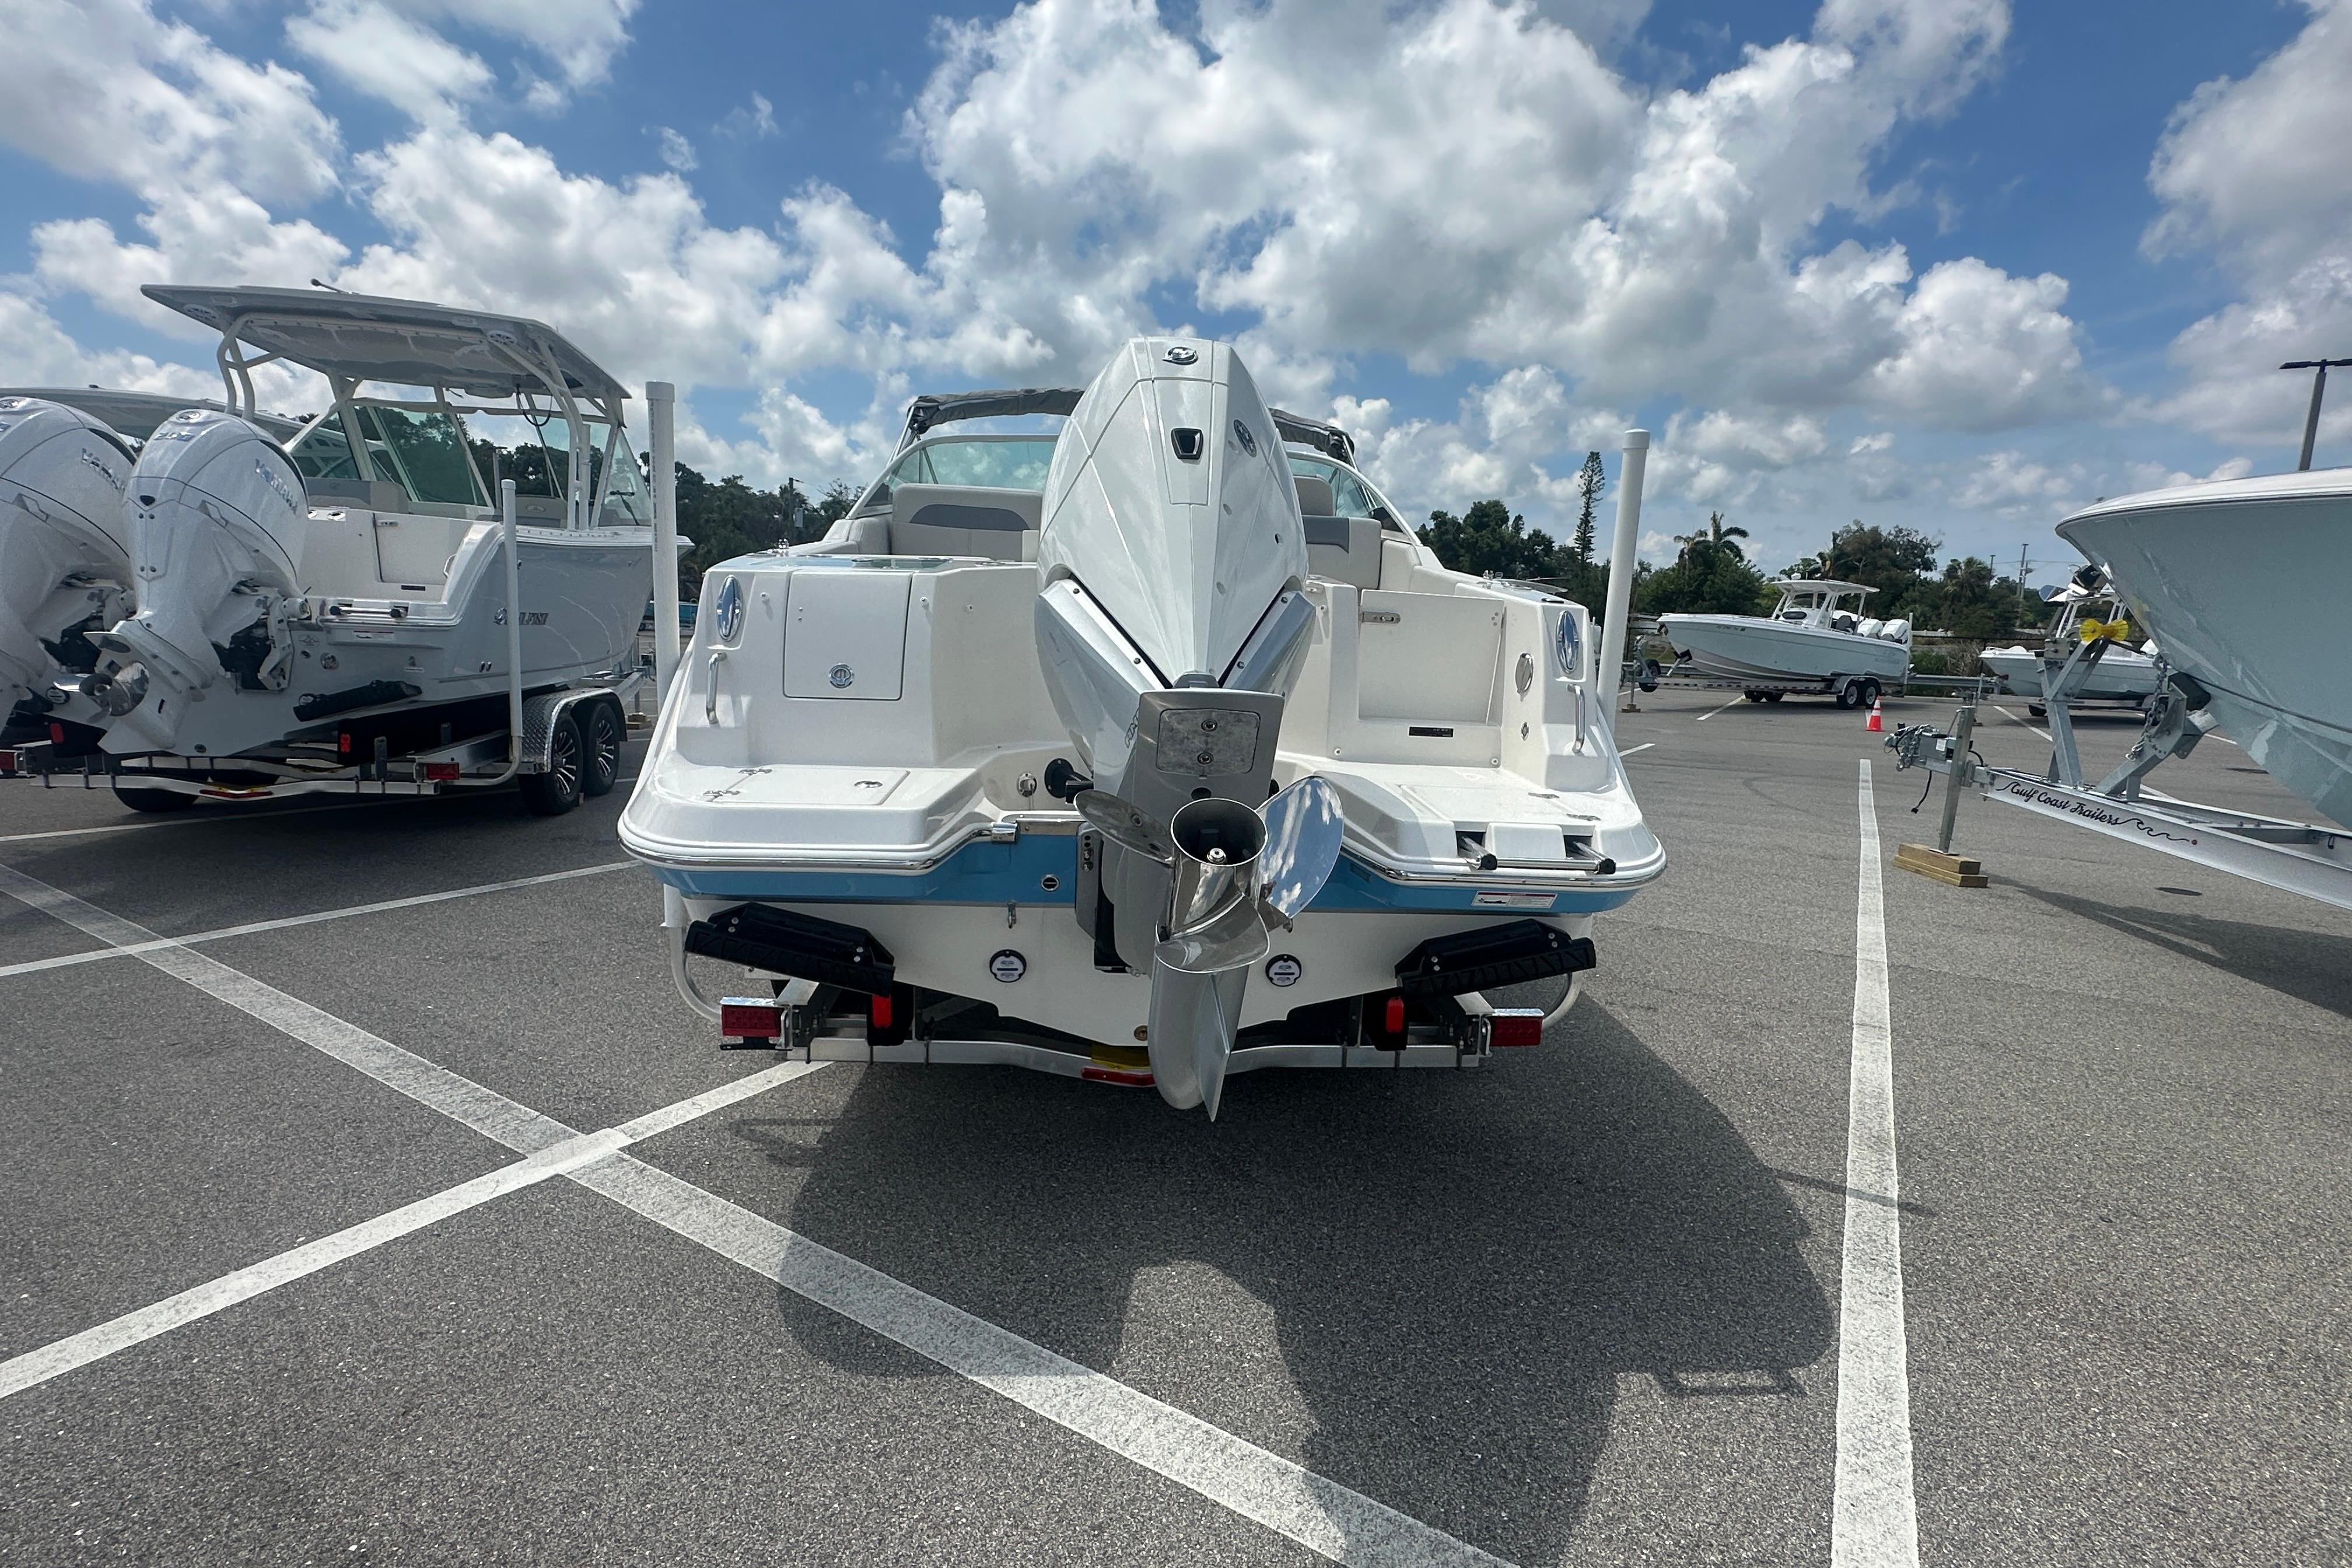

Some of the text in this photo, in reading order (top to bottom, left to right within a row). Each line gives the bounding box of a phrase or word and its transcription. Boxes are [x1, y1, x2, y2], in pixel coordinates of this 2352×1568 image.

[2010, 781, 2123, 826] Gulf Coast Trailers
